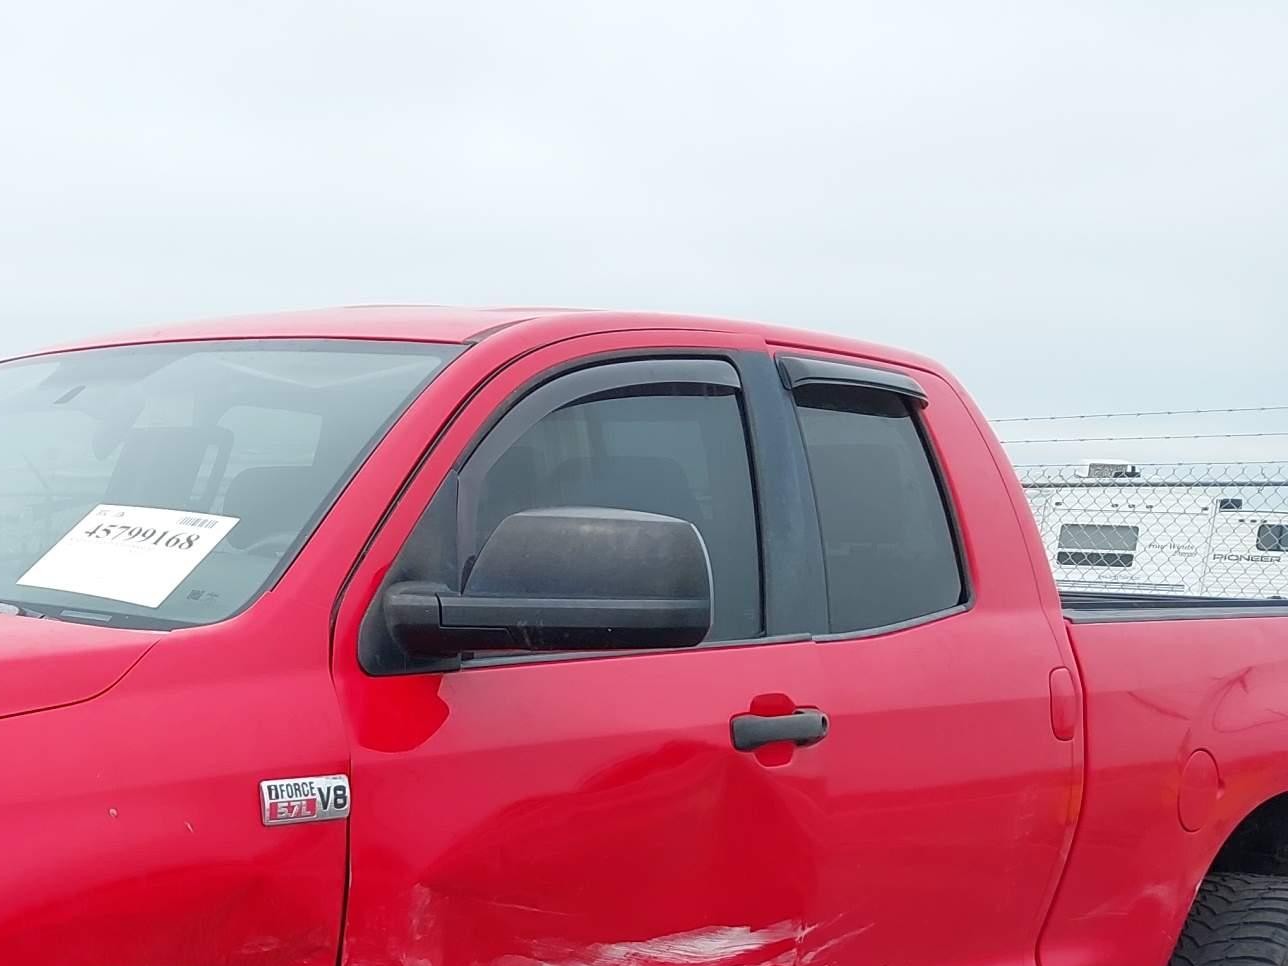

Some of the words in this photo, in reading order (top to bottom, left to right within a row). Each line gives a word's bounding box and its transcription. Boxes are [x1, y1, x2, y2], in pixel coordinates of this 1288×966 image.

[85, 523, 200, 550] 45799168
[1213, 554, 1281, 563] PIONEER
[317, 785, 347, 810] V8
